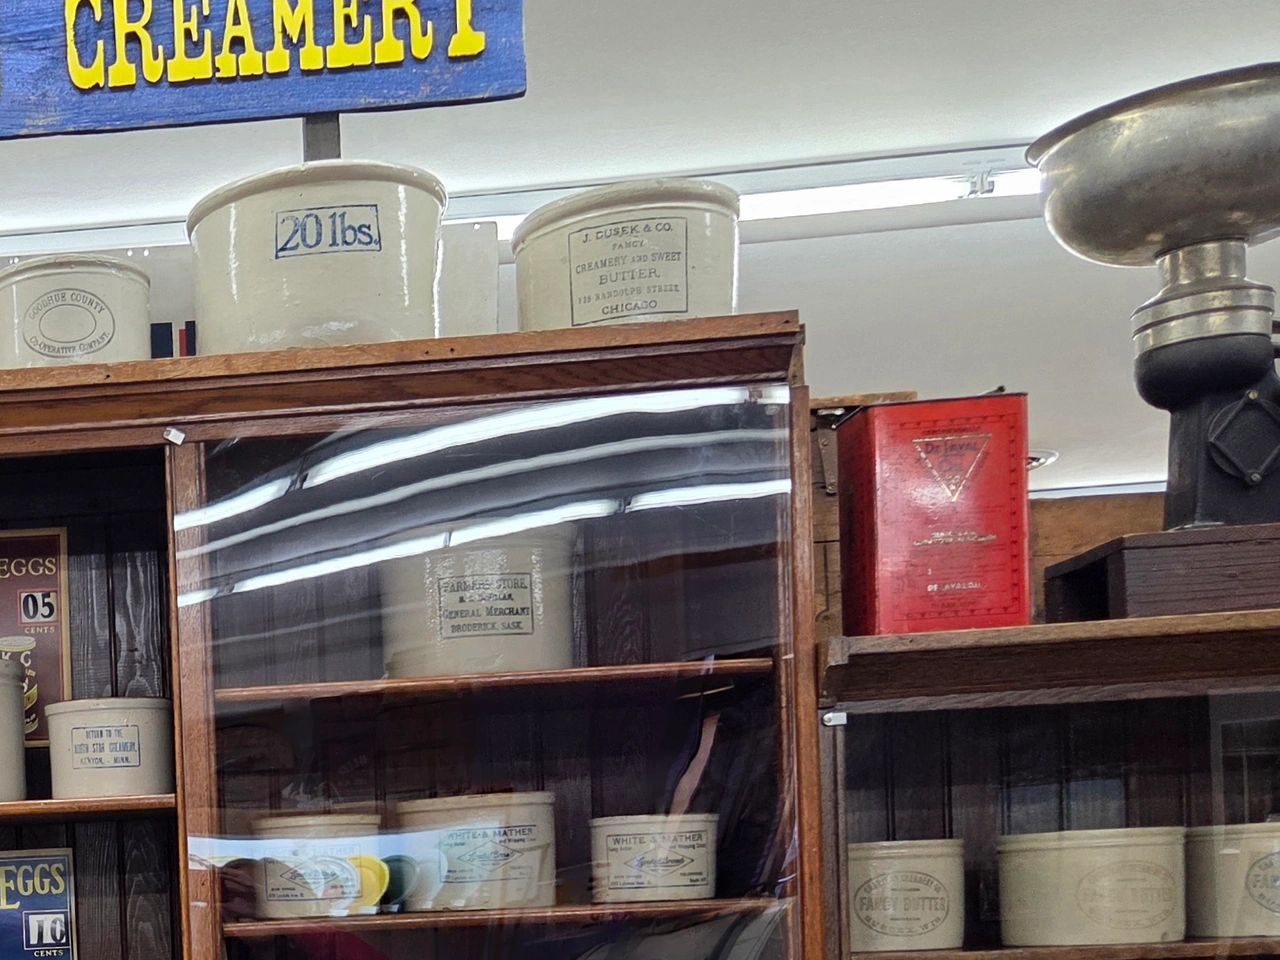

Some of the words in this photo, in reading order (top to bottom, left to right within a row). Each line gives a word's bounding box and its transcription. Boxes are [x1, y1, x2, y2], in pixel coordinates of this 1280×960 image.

[279, 213, 323, 251] 20
[328, 210, 379, 248] lbs.
[643, 223, 653, 233] &
[655, 222, 673, 232] CO.
[575, 255, 627, 274] CREAMERY
[650, 251, 683, 262] SWEET
[598, 267, 660, 285] BUTTER
[28, 292, 67, 321] GOODHUE
[69, 291, 106, 315] COUNTY
[601, 300, 658, 316] CHICAGO
[22, 592, 56, 620] 05
[442, 608, 482, 620] GENERAL
[485, 605, 531, 617] MERCHANT
[493, 828, 533, 839] MATHER
[613, 836, 646, 846] WHITE
[36, 917, 66, 944] 10
